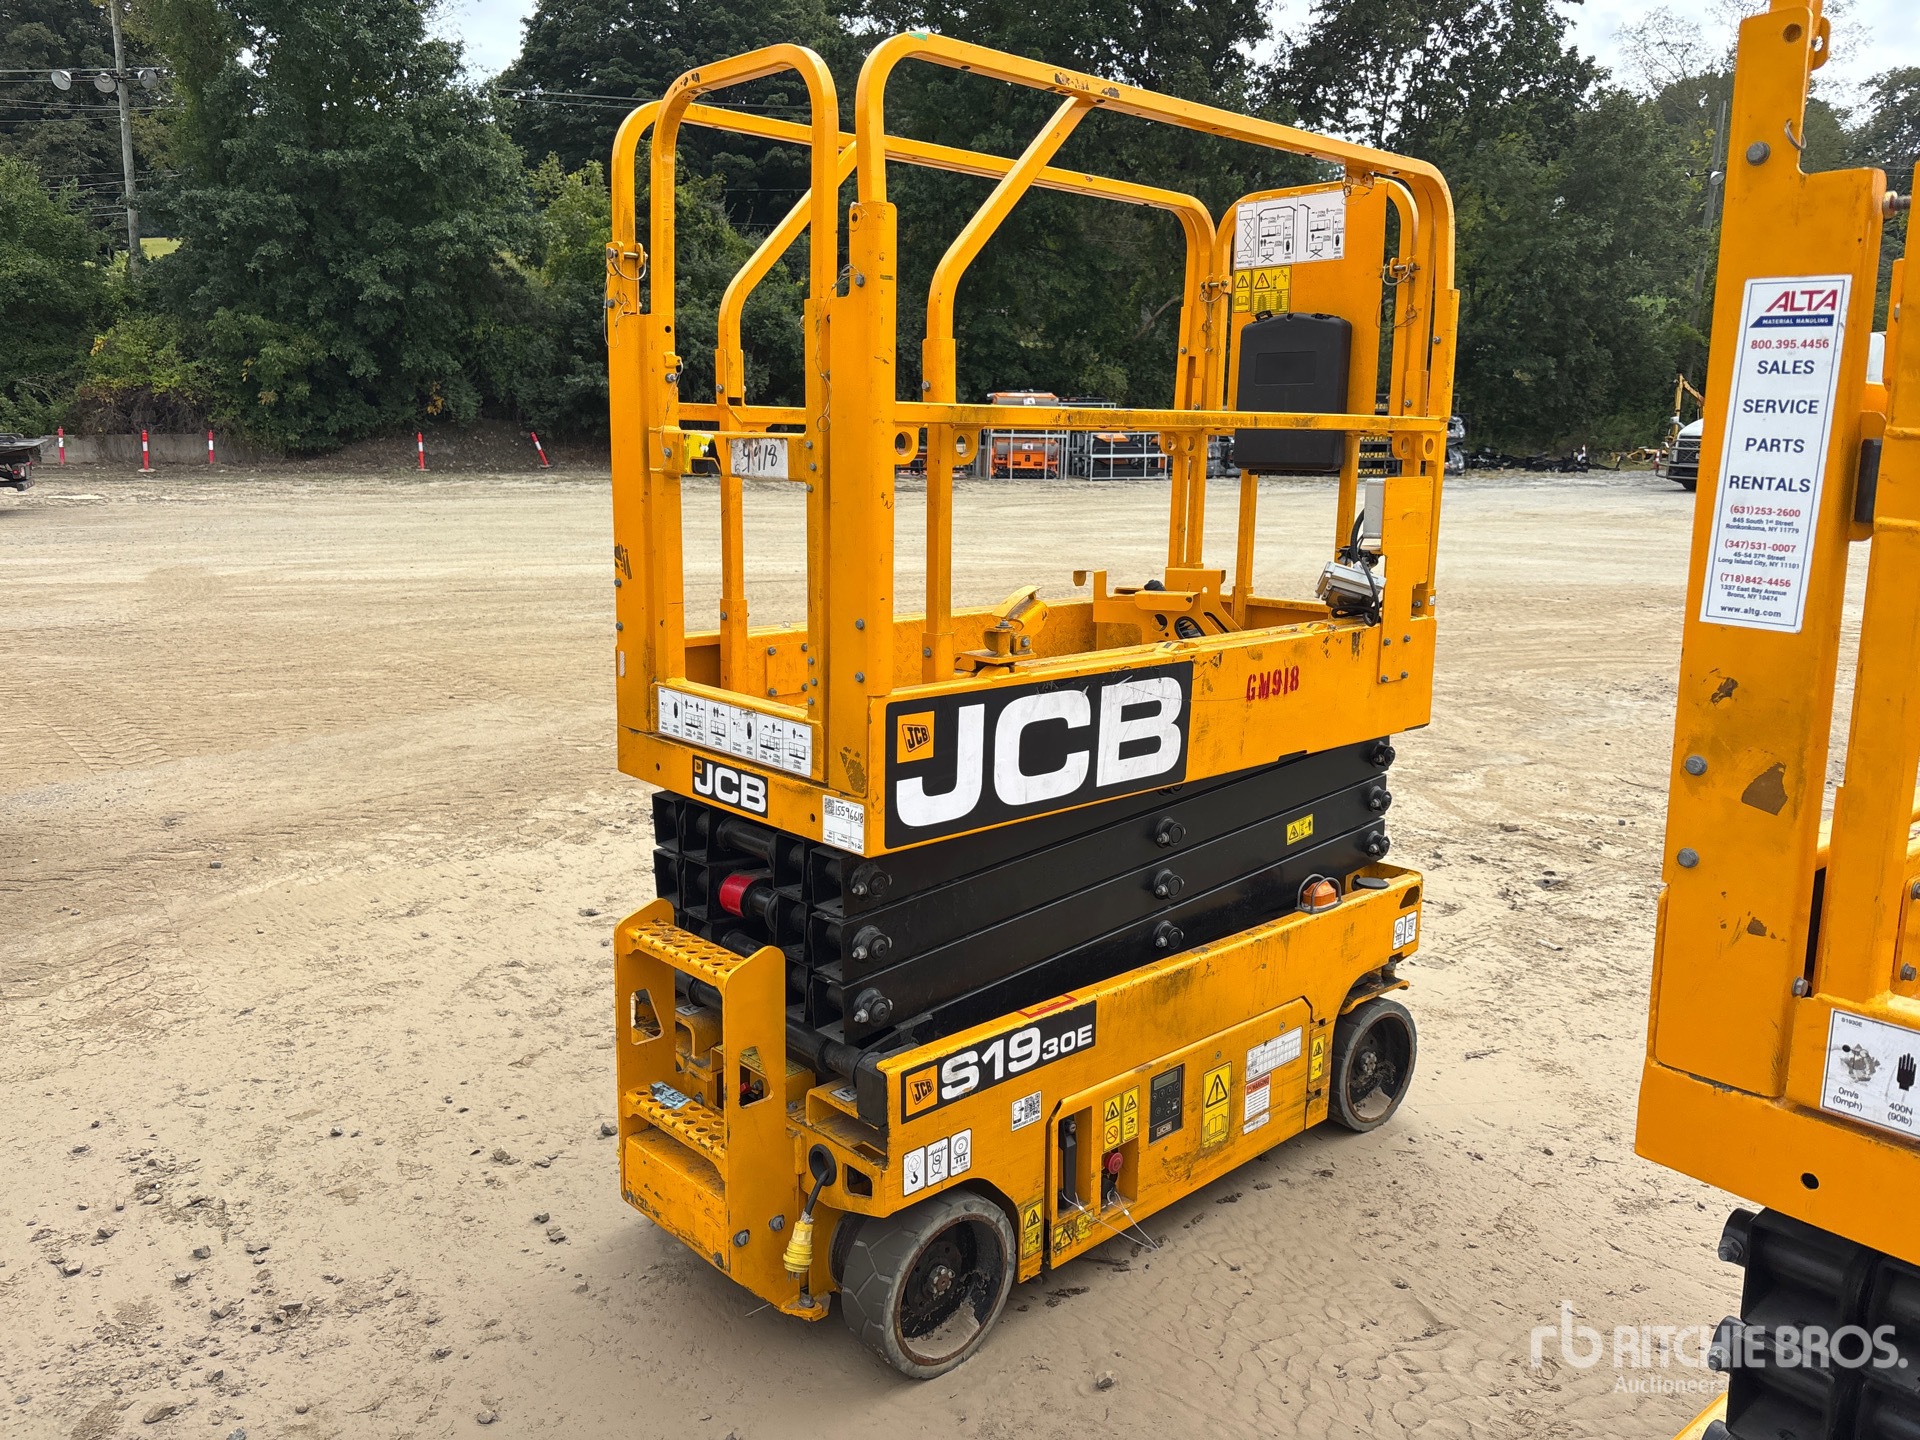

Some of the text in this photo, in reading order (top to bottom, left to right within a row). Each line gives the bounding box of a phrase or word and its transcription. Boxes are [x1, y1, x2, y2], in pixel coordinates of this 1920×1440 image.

[1765, 289, 1838, 312] ALTA
[1751, 339, 1829, 349] 800.395.4456
[1757, 360, 1815, 374] SALES
[1742, 399, 1819, 414] SERVICE
[1745, 438, 1805, 453] PARTS
[1729, 475, 1811, 492] RENTALS
[1730, 504, 1801, 517] (631)253-2600
[1725, 523, 1767, 532] Ronkonkoma,
[1725, 539, 1796, 553] (347)531-0007
[1720, 572, 1791, 588] (718)842-4456
[1727, 591, 1746, 599] Bronx,
[1758, 594, 1778, 602] 10474
[1764, 588, 1787, 596] Avenue
[1720, 605, 1782, 618] www.altg.com
[1246, 665, 1300, 702] GM918
[907, 727, 928, 749] JCB
[896, 676, 1182, 827] JCB
[694, 762, 767, 813] JCB
[1841, 1017, 1863, 1028] S1930E
[914, 1080, 933, 1101] JCB
[1838, 1086, 1859, 1099] 0m/s
[1832, 1094, 1863, 1112] (0mph)
[1888, 1102, 1914, 1116] 400N
[1887, 1111, 1913, 1127] (90lb)
